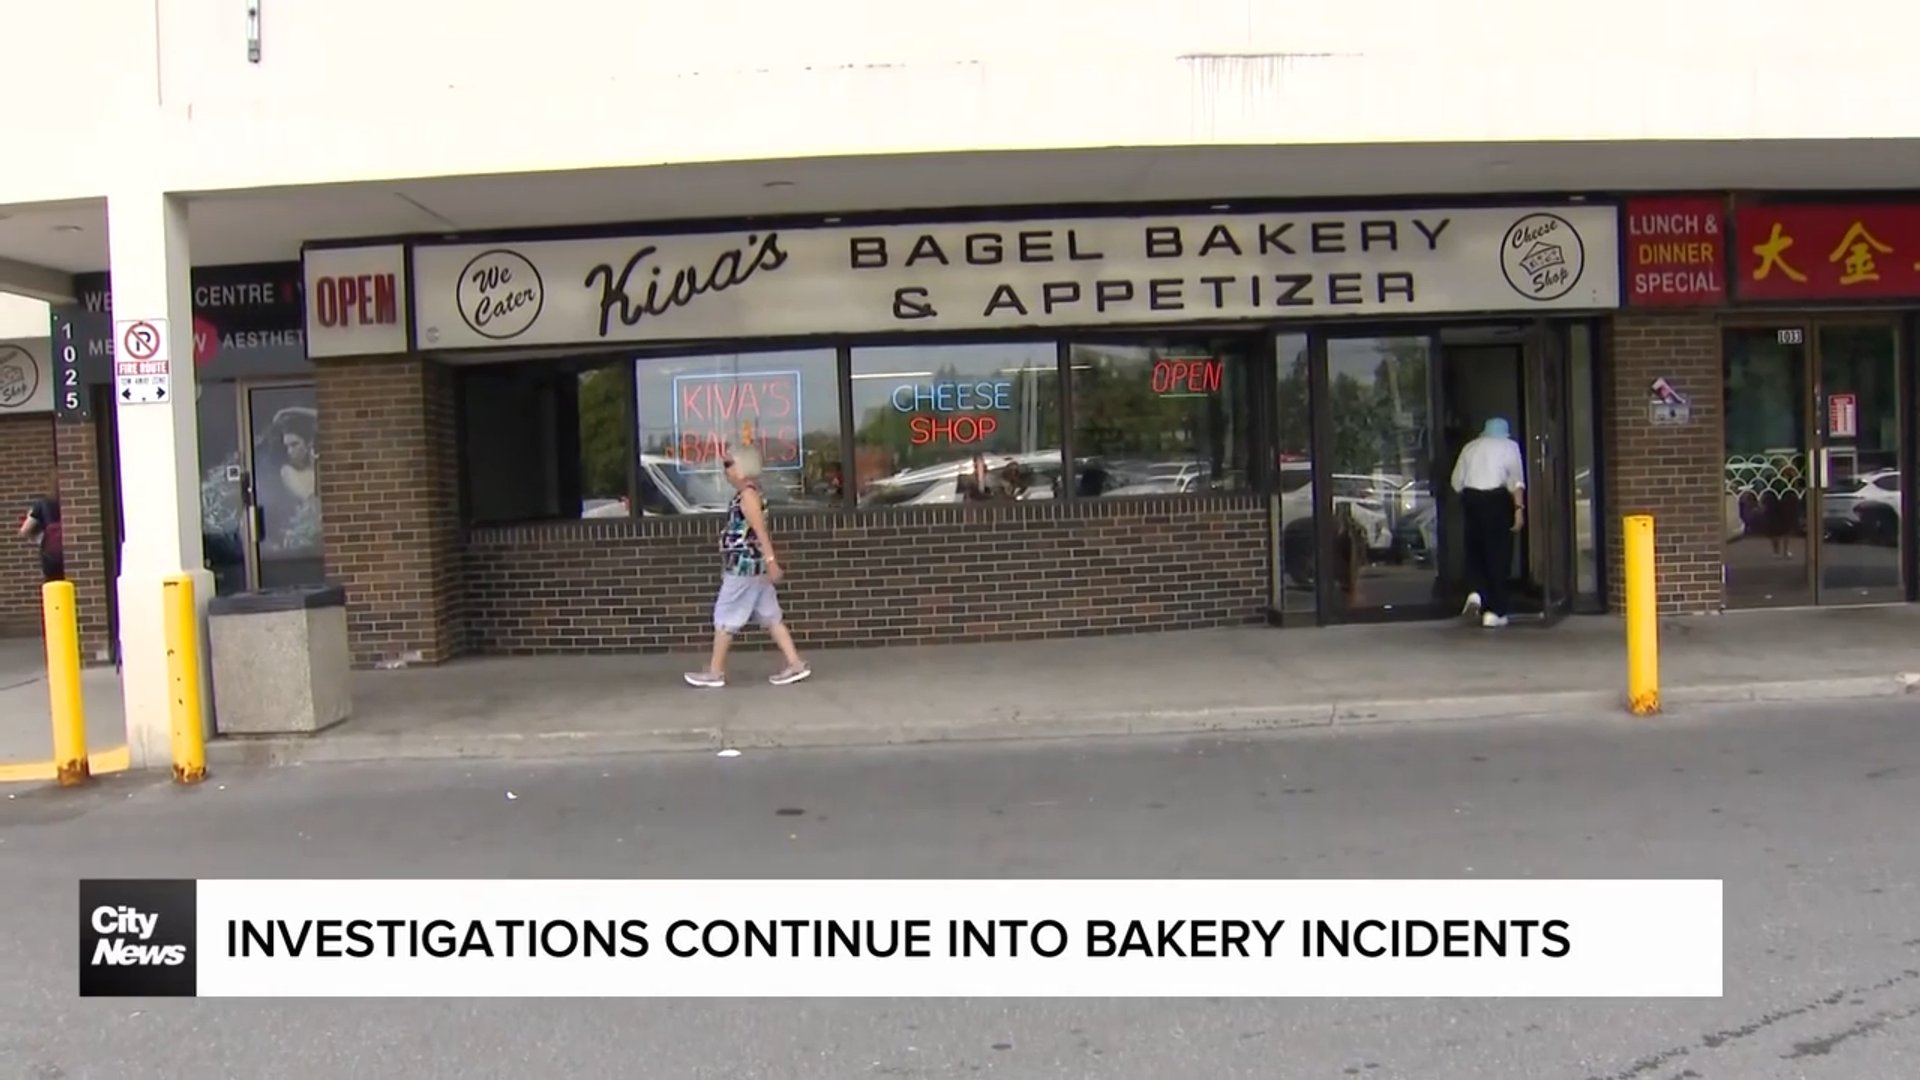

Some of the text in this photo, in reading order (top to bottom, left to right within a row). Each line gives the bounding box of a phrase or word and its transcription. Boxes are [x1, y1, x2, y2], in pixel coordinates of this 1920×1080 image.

[1511, 219, 1558, 249] Cheese
[1629, 214, 1718, 235] LUNCH &
[1638, 242, 1714, 265] DINNER
[1752, 221, 1920, 285] 大金
[472, 265, 512, 294] We
[584, 217, 1451, 336] Kiva's BAGEL BAKERY
[1532, 266, 1569, 293] Shop
[1635, 271, 1720, 293] SPECIAL
[195, 283, 275, 307] CENTRE
[316, 273, 397, 328] OPEN
[474, 288, 535, 327] Cater
[892, 271, 1416, 318] & APPETIZER
[61, 322, 79, 409] 1025
[119, 361, 168, 375] FIRE ROUTE
[1151, 359, 1222, 393] OPEN
[682, 380, 791, 422] KIVA'S
[892, 383, 1011, 413] CHEESE
[909, 416, 997, 445] SHOP
